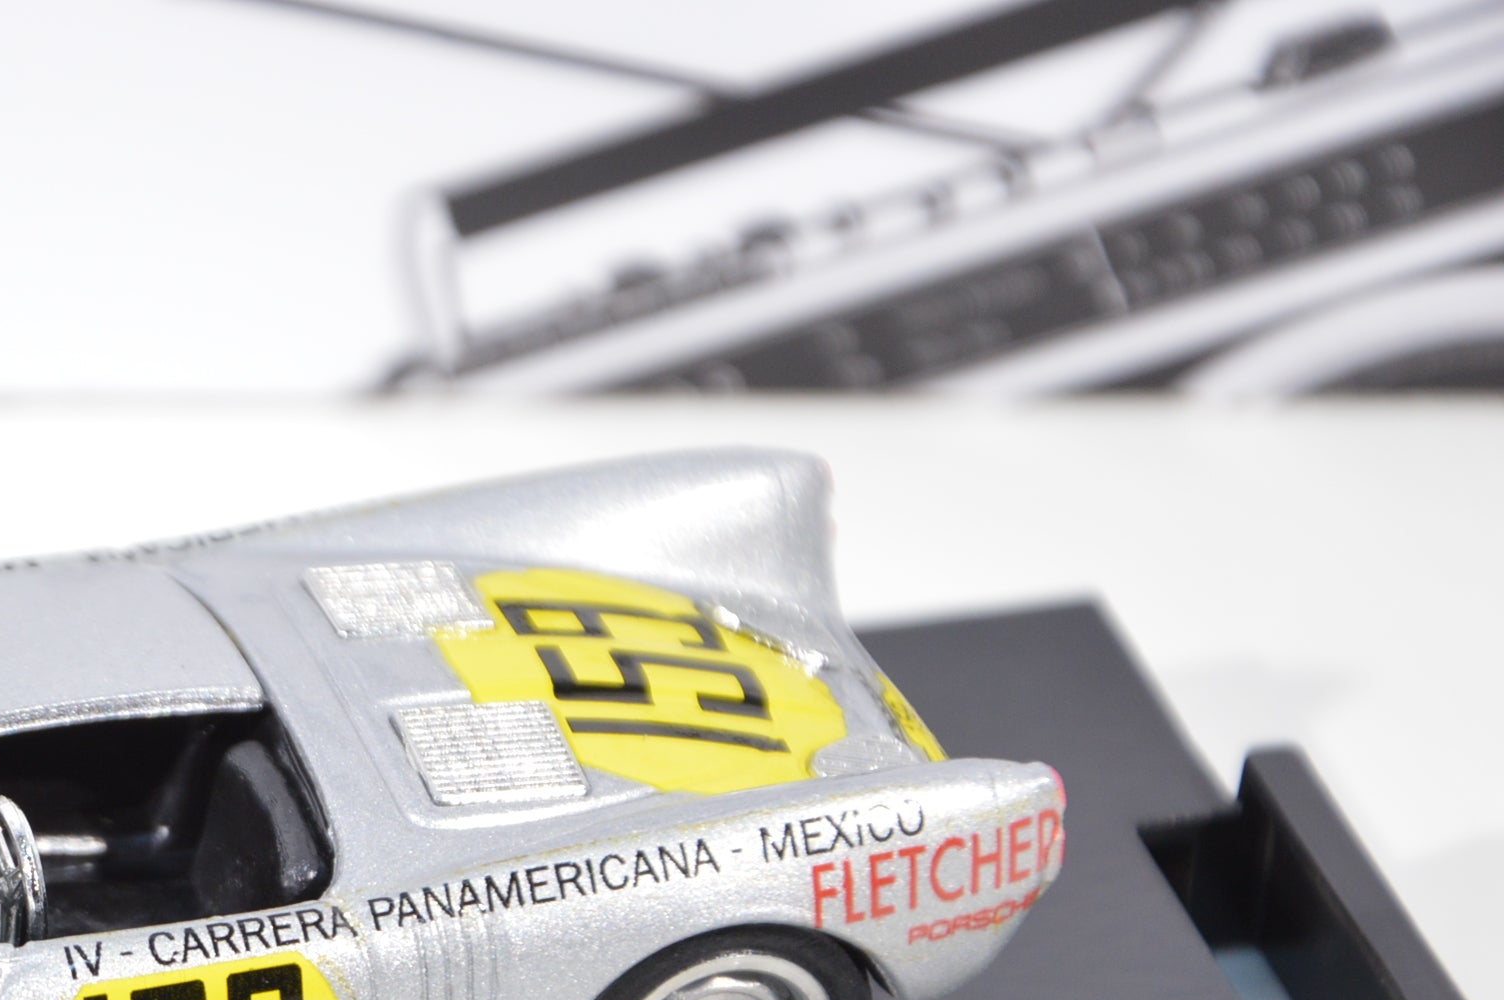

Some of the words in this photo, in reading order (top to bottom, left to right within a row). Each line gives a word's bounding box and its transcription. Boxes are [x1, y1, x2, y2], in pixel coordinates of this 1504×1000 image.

[65, 943, 103, 980] IV
[148, 905, 357, 966] CARRERA
[369, 841, 721, 931] PANAMERICANA
